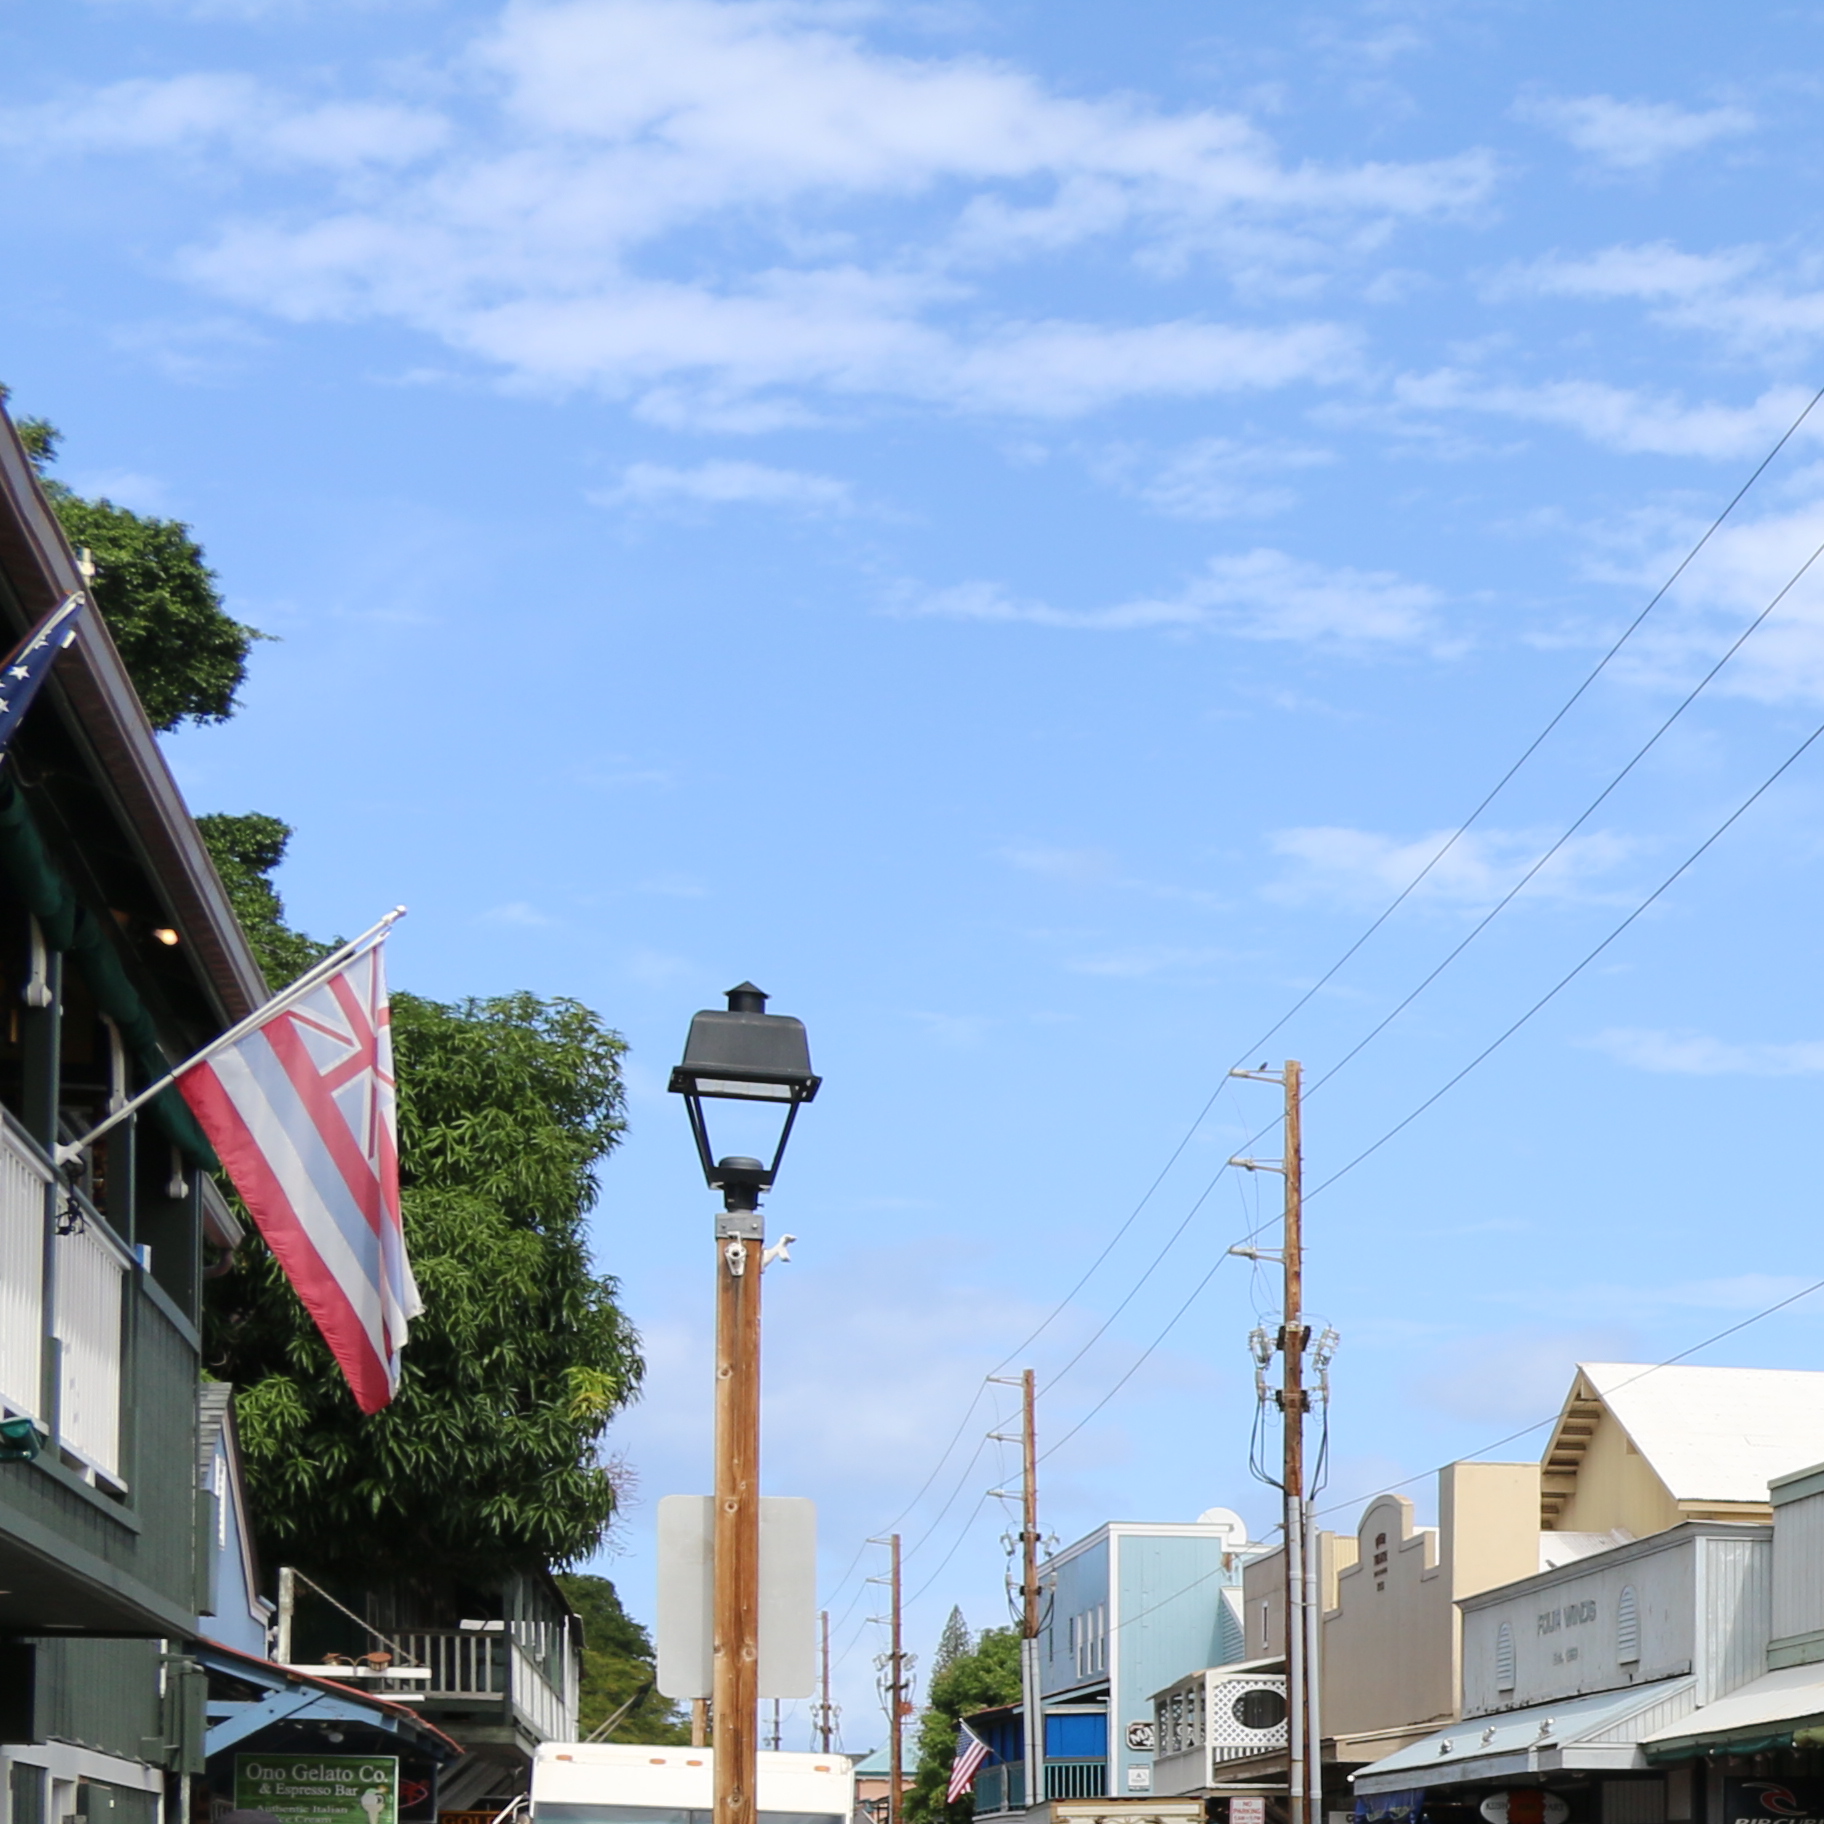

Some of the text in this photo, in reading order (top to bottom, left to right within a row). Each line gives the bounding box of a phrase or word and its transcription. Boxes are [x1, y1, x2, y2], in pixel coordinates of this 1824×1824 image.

[246, 1763, 389, 1783] Ono Gelato Co.
[259, 1783, 359, 1797] & Espresso Bar
[256, 1804, 348, 1815] Authentic Italian
[295, 1815, 332, 1824] Cream
